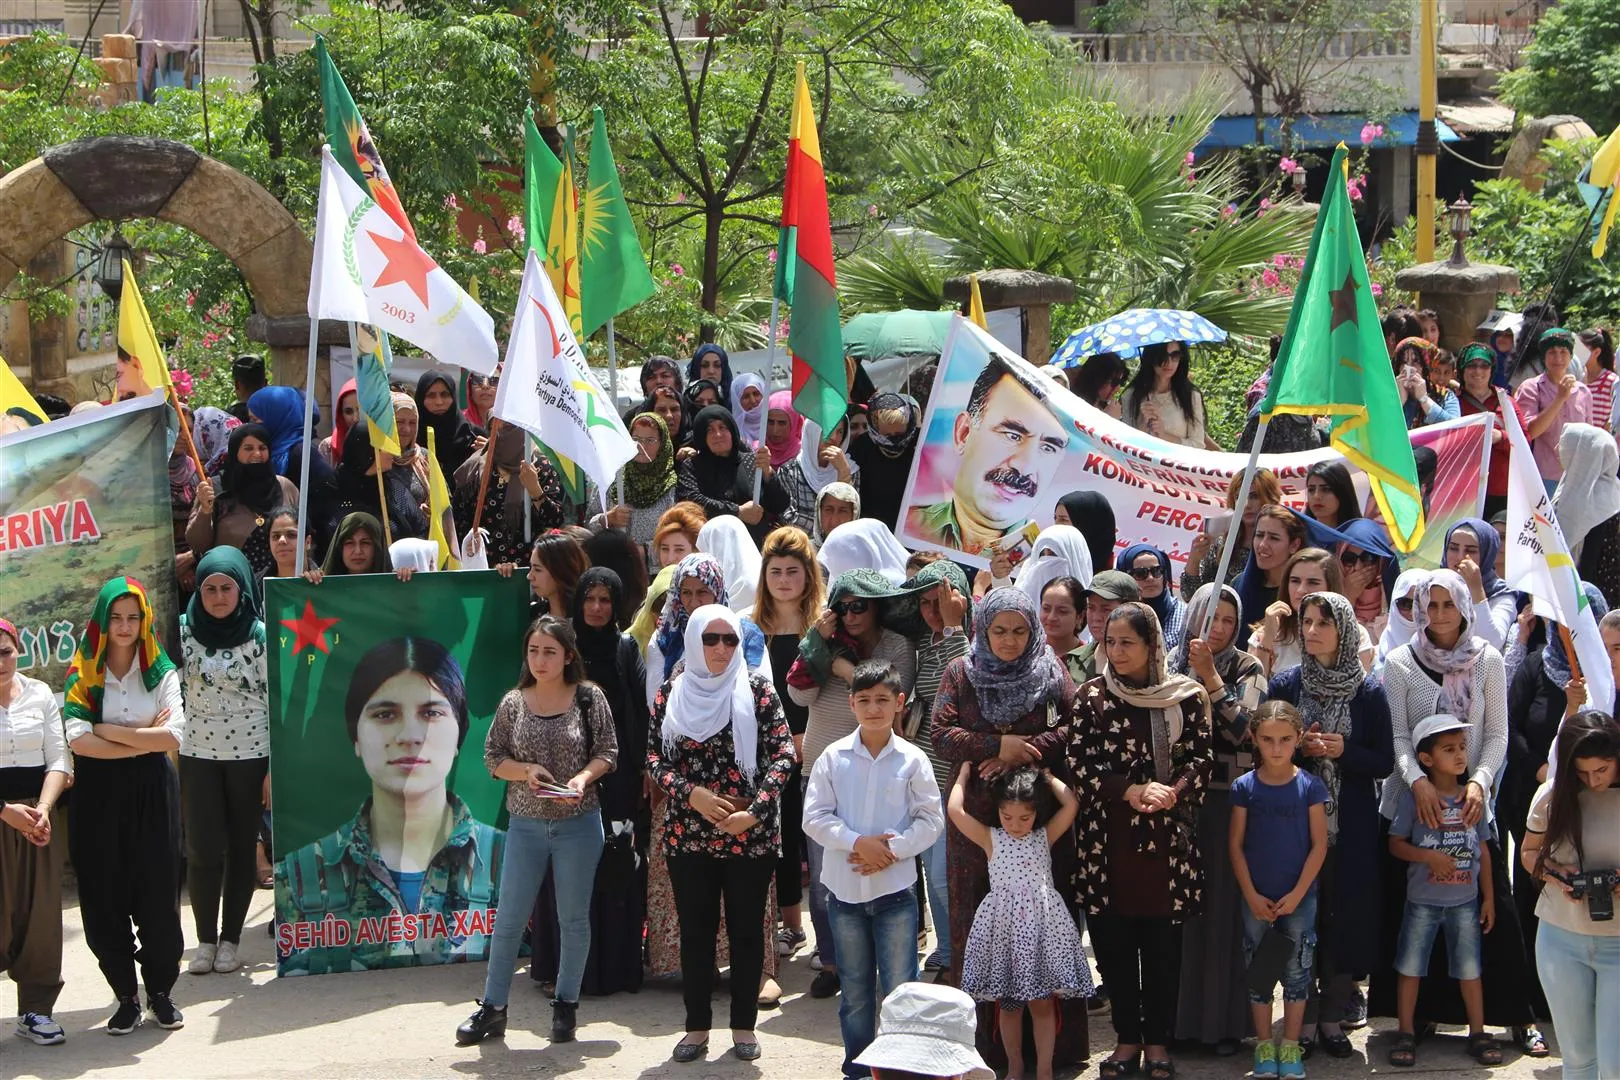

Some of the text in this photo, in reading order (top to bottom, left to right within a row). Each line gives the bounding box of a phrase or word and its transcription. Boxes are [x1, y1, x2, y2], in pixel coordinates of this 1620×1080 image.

[382, 302, 416, 324] 2003
[534, 382, 557, 405] Partiya
[280, 633, 339, 648] Y J
[307, 654, 316, 665] P
[278, 912, 352, 957] ŞEHÎD
[355, 908, 449, 946] AVÊSTA
